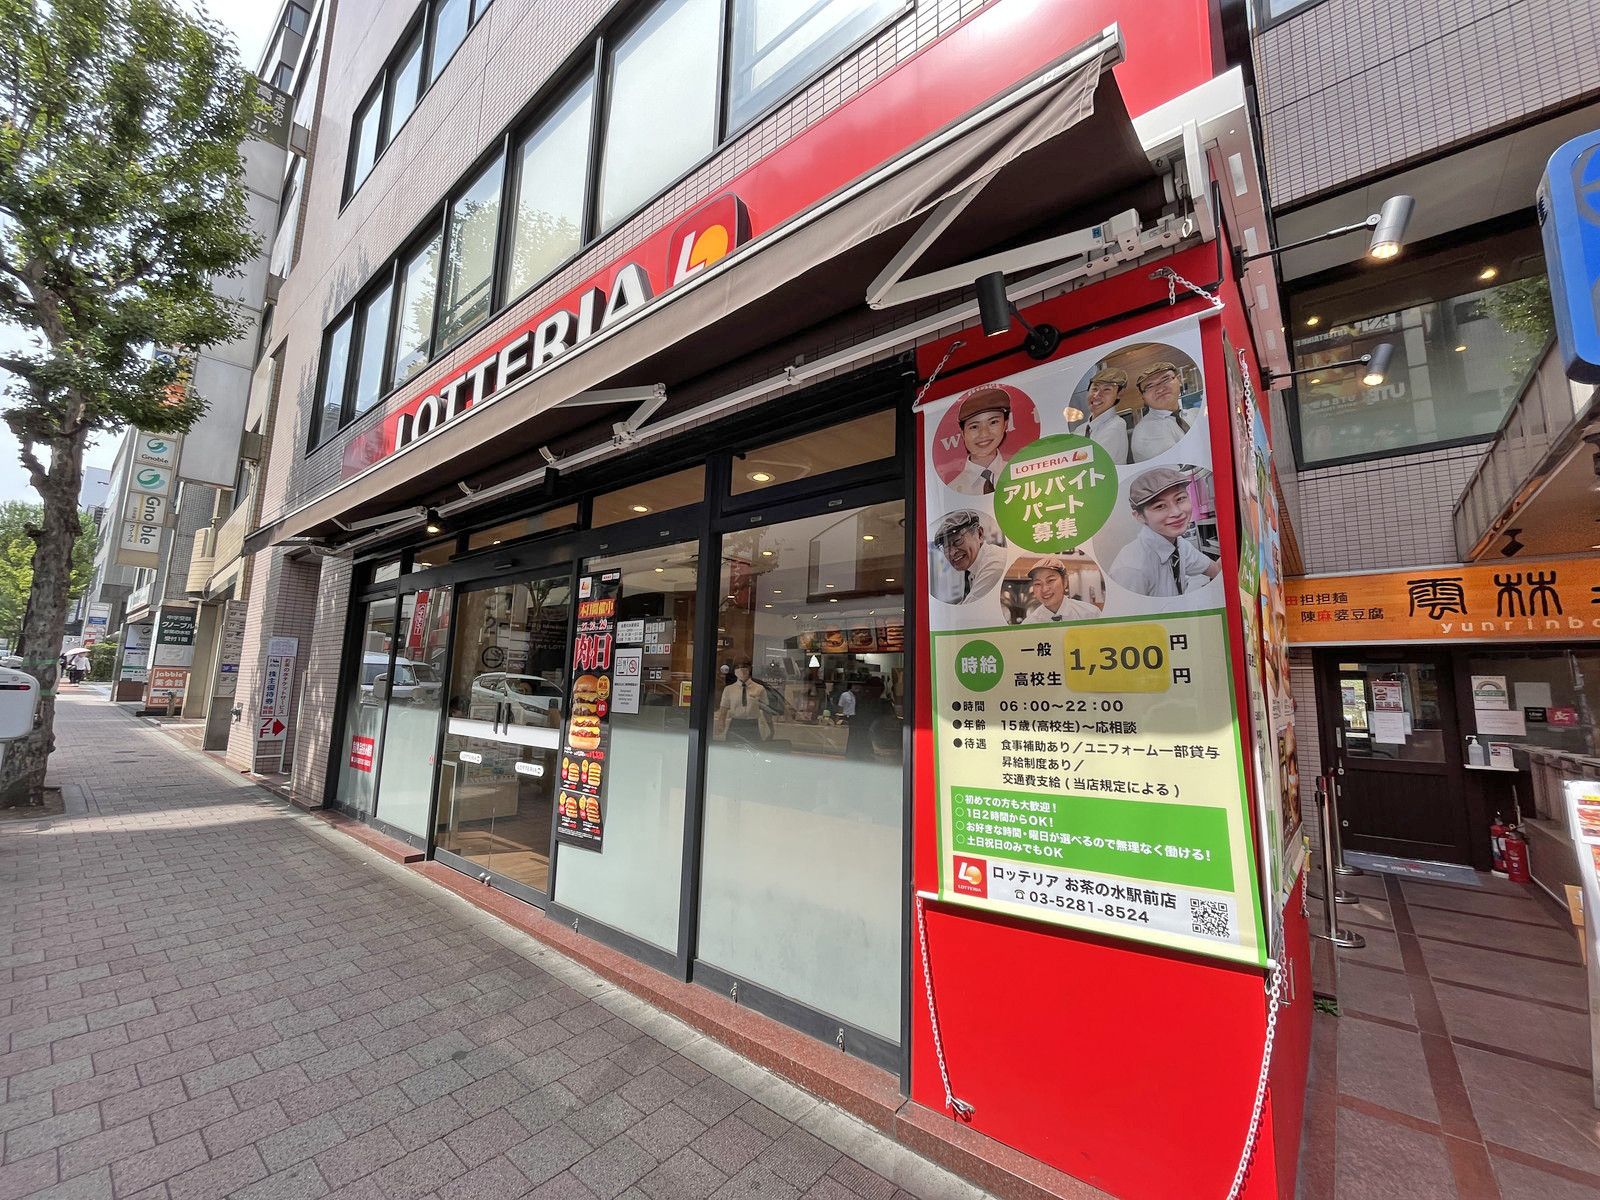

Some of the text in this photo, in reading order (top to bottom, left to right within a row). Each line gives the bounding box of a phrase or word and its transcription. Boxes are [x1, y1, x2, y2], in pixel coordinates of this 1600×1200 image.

[394, 262, 654, 452] LOTTERIA
[141, 453, 169, 464] Gnoble
[1015, 456, 1069, 475] LOTTERIA
[1003, 467, 1106, 505] アルバイト
[1022, 494, 1085, 522] パート
[1031, 517, 1078, 544] 募集
[161, 621, 195, 630] グノーブル
[1301, 607, 1384, 623] 陳麻婆豆腐
[961, 655, 998, 675] 時給
[1020, 634, 1188, 676] 一般 1,300 円
[1014, 667, 1192, 687] 高校生 円
[966, 835, 1063, 859] 土日祝日のみでもOK
[957, 884, 982, 893] LOTTERIA
[992, 866, 1177, 910] ロッテリア お茶の水駅前店
[1029, 890, 1150, 924] 03-5281-8524
